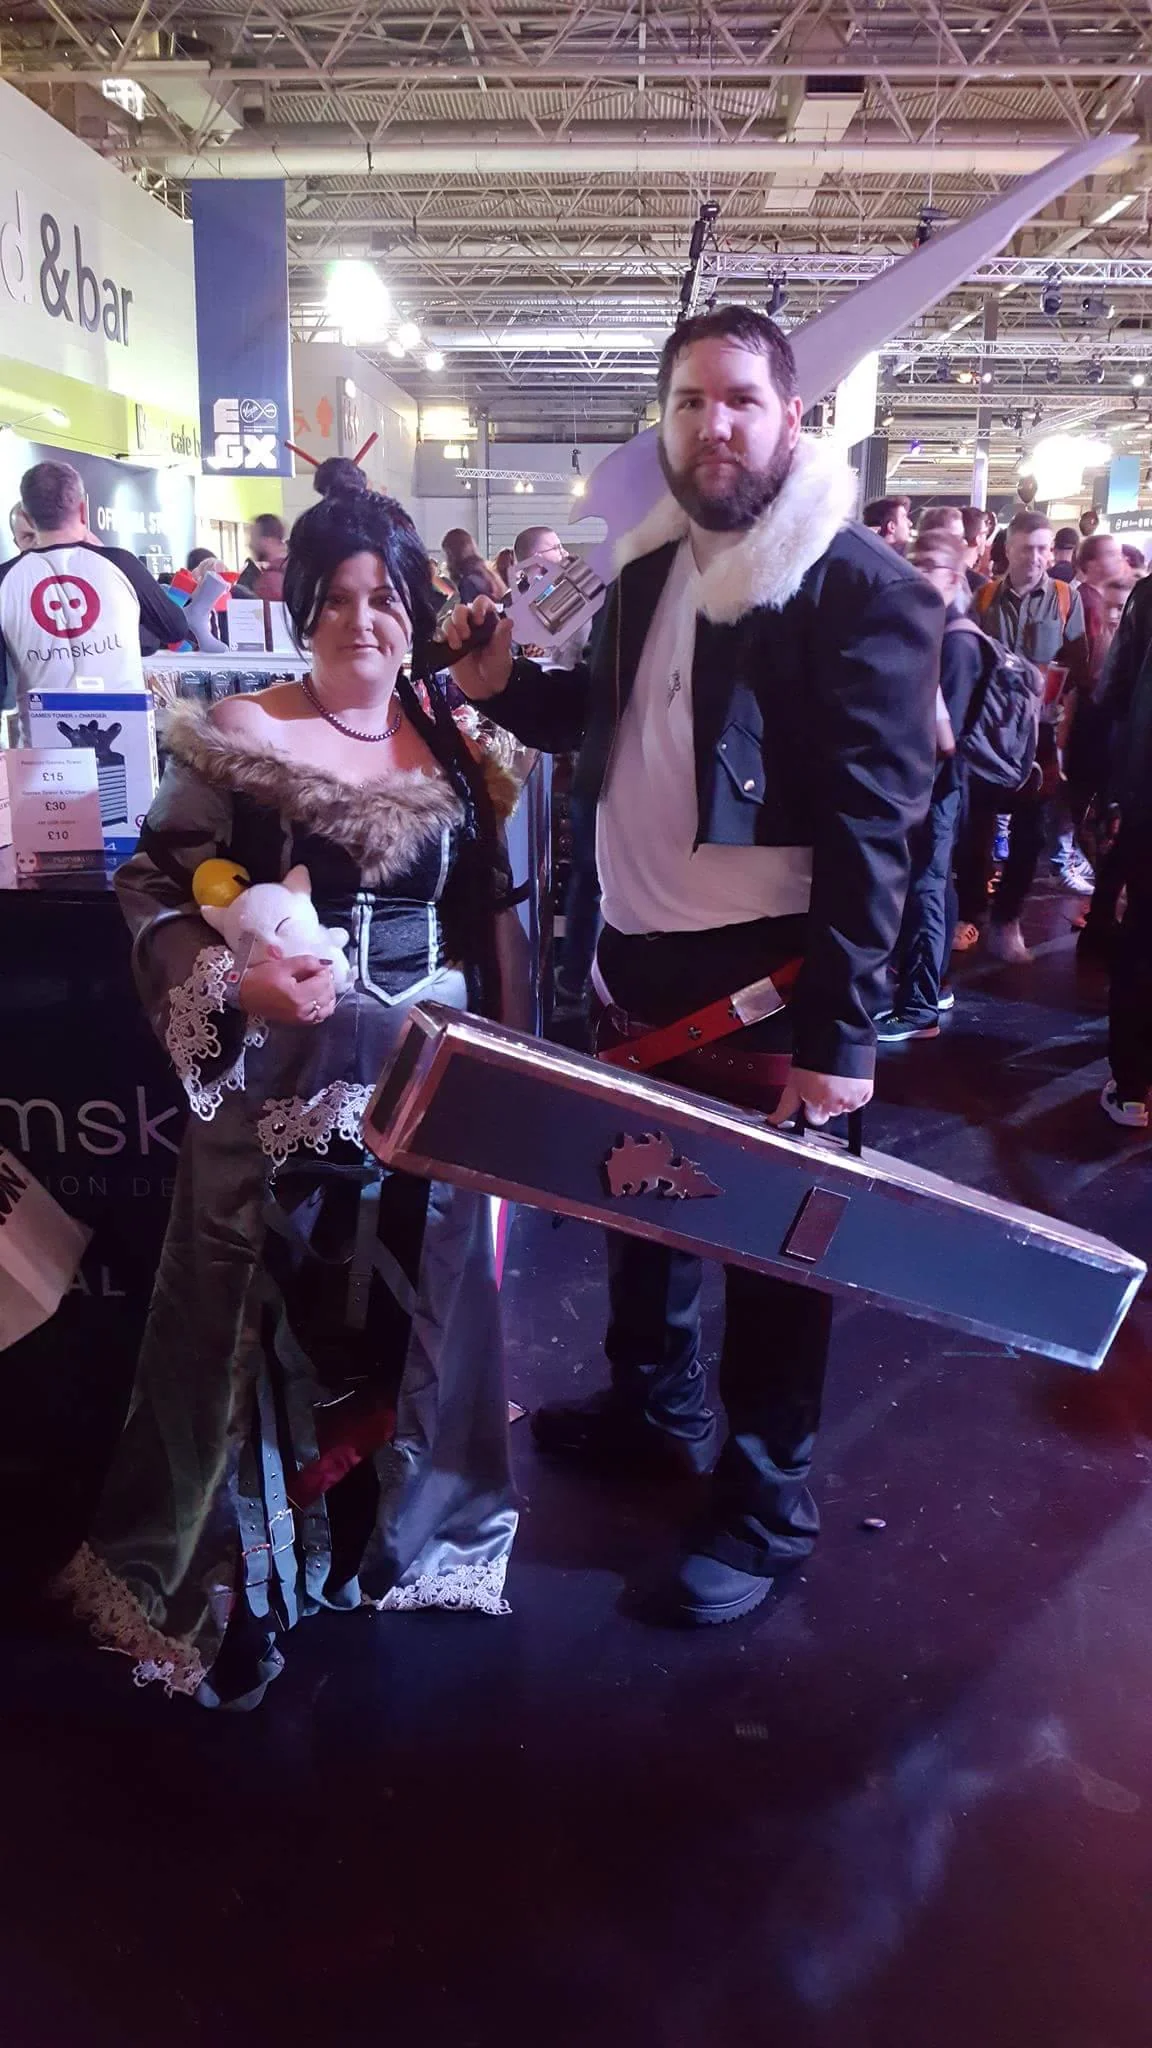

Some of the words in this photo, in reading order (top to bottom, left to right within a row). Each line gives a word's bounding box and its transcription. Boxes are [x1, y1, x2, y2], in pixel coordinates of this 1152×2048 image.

[40, 213, 73, 322] &
[74, 224, 133, 347] bar
[27, 633, 122, 662] numskull
[42, 772, 64, 782] £15
[45, 801, 66, 811] £30
[47, 831, 69, 840] £10
